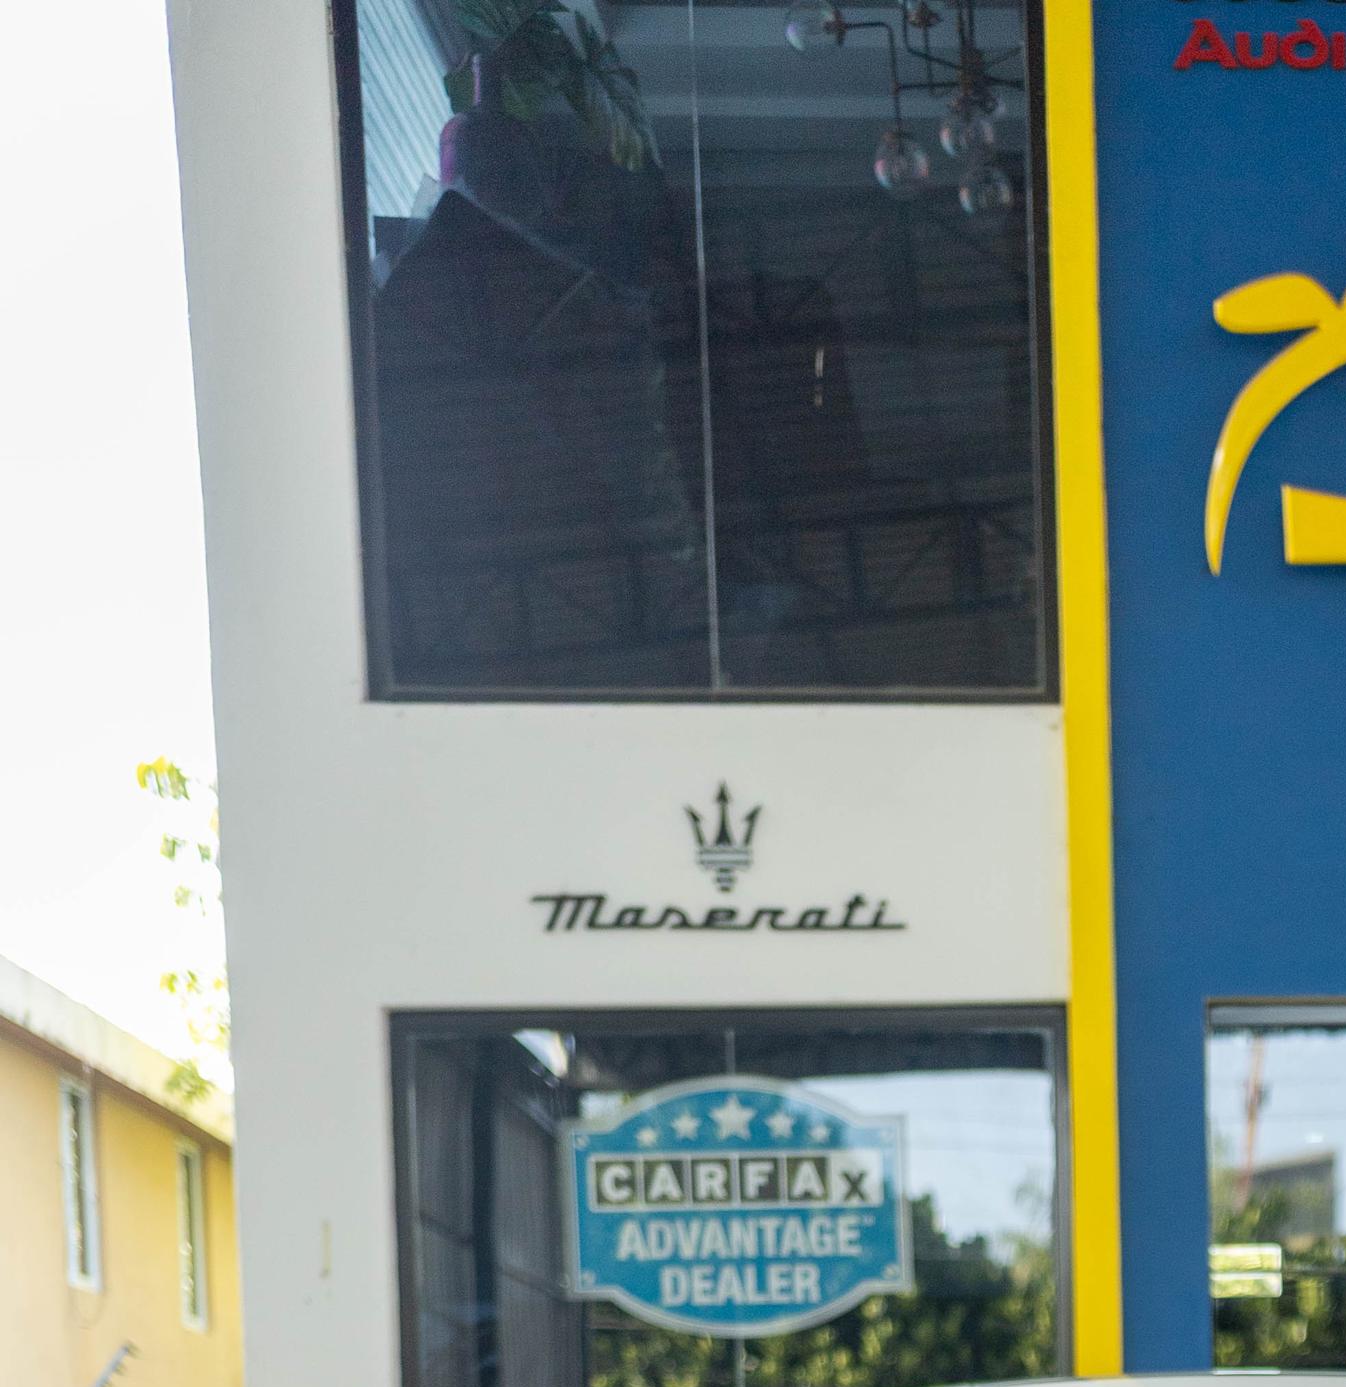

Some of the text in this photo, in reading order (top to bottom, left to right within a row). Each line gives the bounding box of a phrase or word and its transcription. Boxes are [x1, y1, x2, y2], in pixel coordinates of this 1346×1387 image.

[529, 893, 908, 933] Maserati
[598, 1158, 868, 1203] CARFAX
[616, 1213, 865, 1262] ADVANTAGE
[659, 1262, 822, 1307] DEALER
